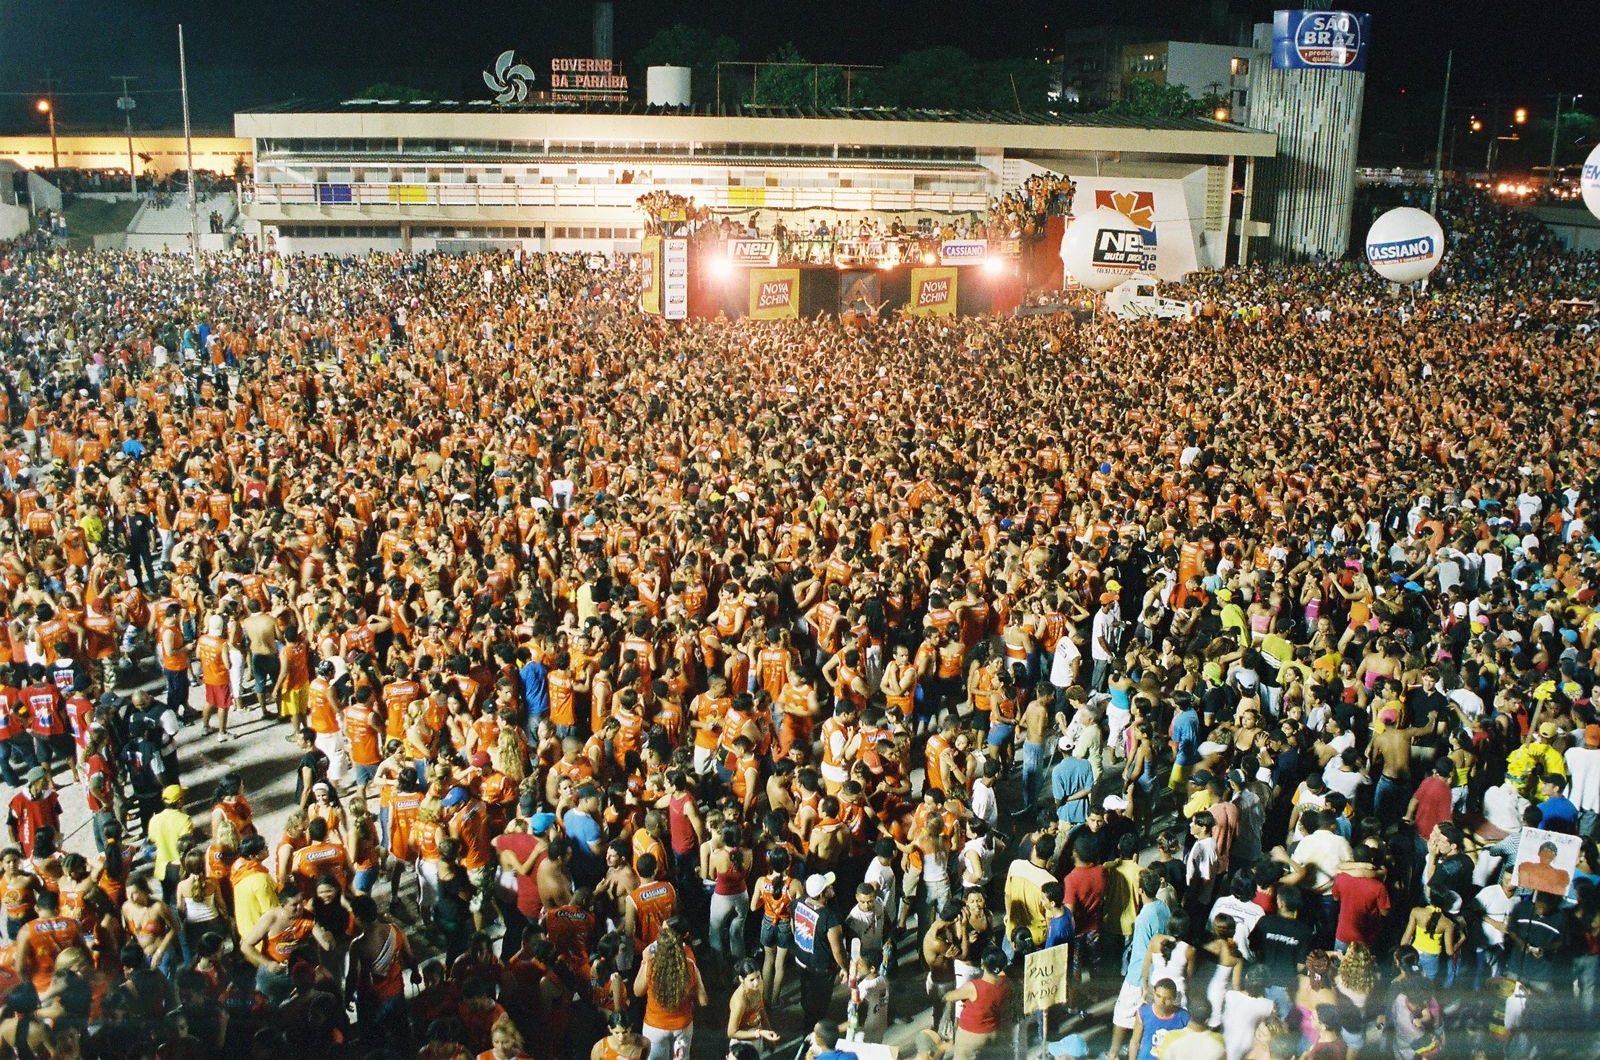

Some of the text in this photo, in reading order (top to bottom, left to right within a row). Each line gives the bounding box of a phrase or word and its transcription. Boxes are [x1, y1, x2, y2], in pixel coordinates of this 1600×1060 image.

[1313, 15, 1350, 33] SÃO
[1304, 31, 1355, 46] BRAZ
[551, 58, 613, 72] GOVERNO
[551, 74, 569, 88] DA
[946, 246, 983, 256] CASSIANO
[1369, 239, 1430, 260] CASSIANO
[763, 282, 789, 295] NOVA
[923, 280, 948, 293] NOVA
[759, 293, 790, 306] SCHIN
[919, 292, 947, 304] SCHIN
[1029, 965, 1054, 978] PAU
